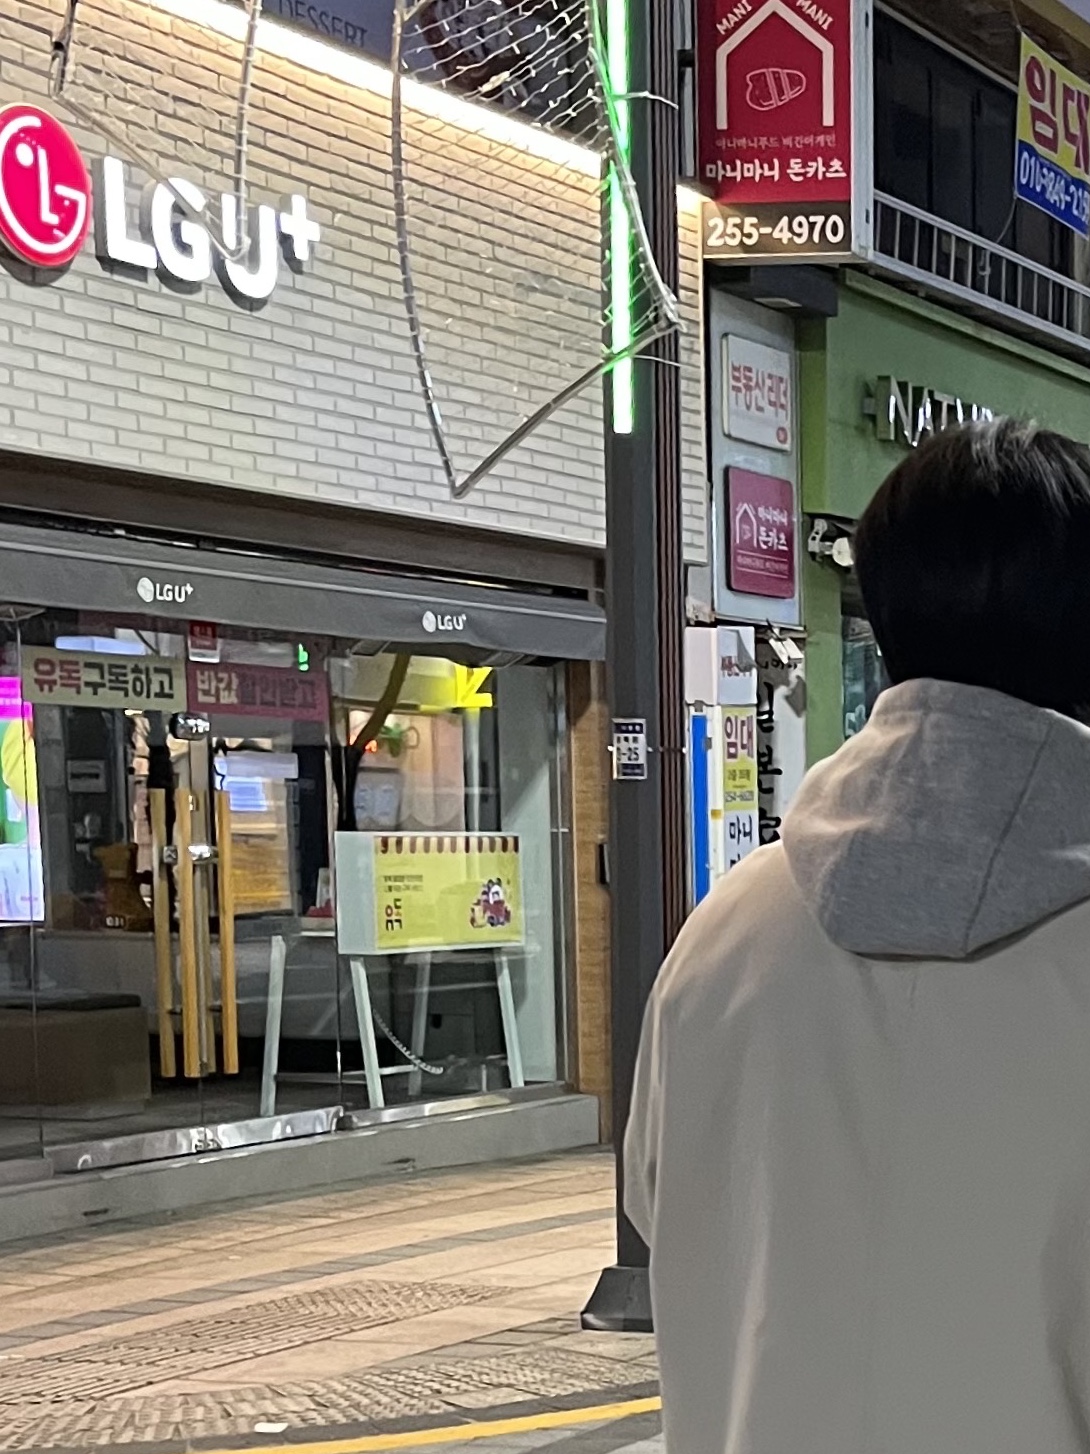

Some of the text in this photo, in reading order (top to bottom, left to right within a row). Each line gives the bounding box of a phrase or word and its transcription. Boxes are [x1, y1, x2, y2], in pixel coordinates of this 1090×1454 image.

[716, 0, 753, 35] MANI
[796, 0, 834, 31] MANI
[1025, 55, 1090, 177] 임대
[705, 156, 847, 183] 마니마니 돈카츠
[706, 214, 845, 247] 255-4970
[724, 714, 754, 760] 임대
